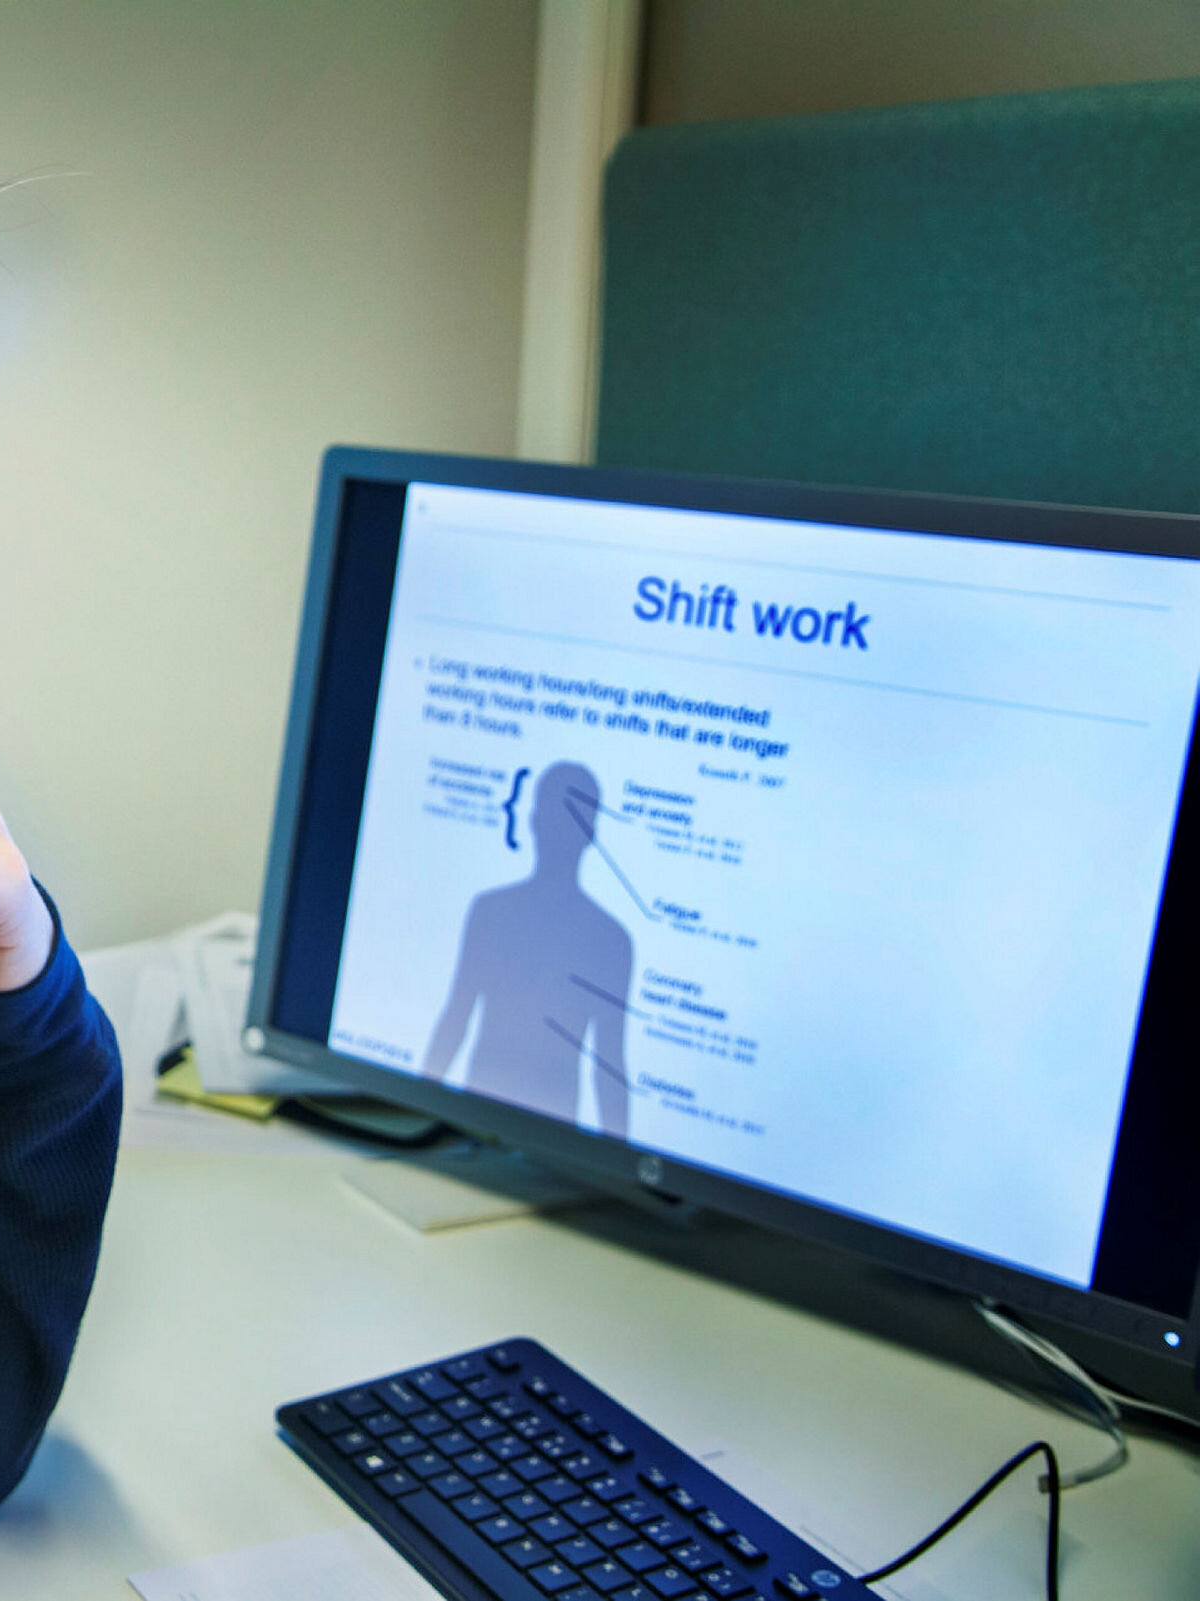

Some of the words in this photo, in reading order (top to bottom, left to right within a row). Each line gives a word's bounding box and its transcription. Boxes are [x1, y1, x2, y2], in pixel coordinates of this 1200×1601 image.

[633, 575, 737, 633] Shift
[752, 599, 871, 650] work
[423, 702, 456, 724] than
[426, 682, 487, 708] working
[489, 690, 536, 713] hours
[538, 699, 579, 721] refer
[582, 704, 601, 724] to
[604, 709, 650, 734] shifts
[654, 717, 691, 742] that
[693, 728, 723, 747] are
[727, 726, 790, 759] longer
[429, 654, 469, 680] Long
[472, 664, 534, 693] working
[631, 685, 772, 728] shifts/extended
